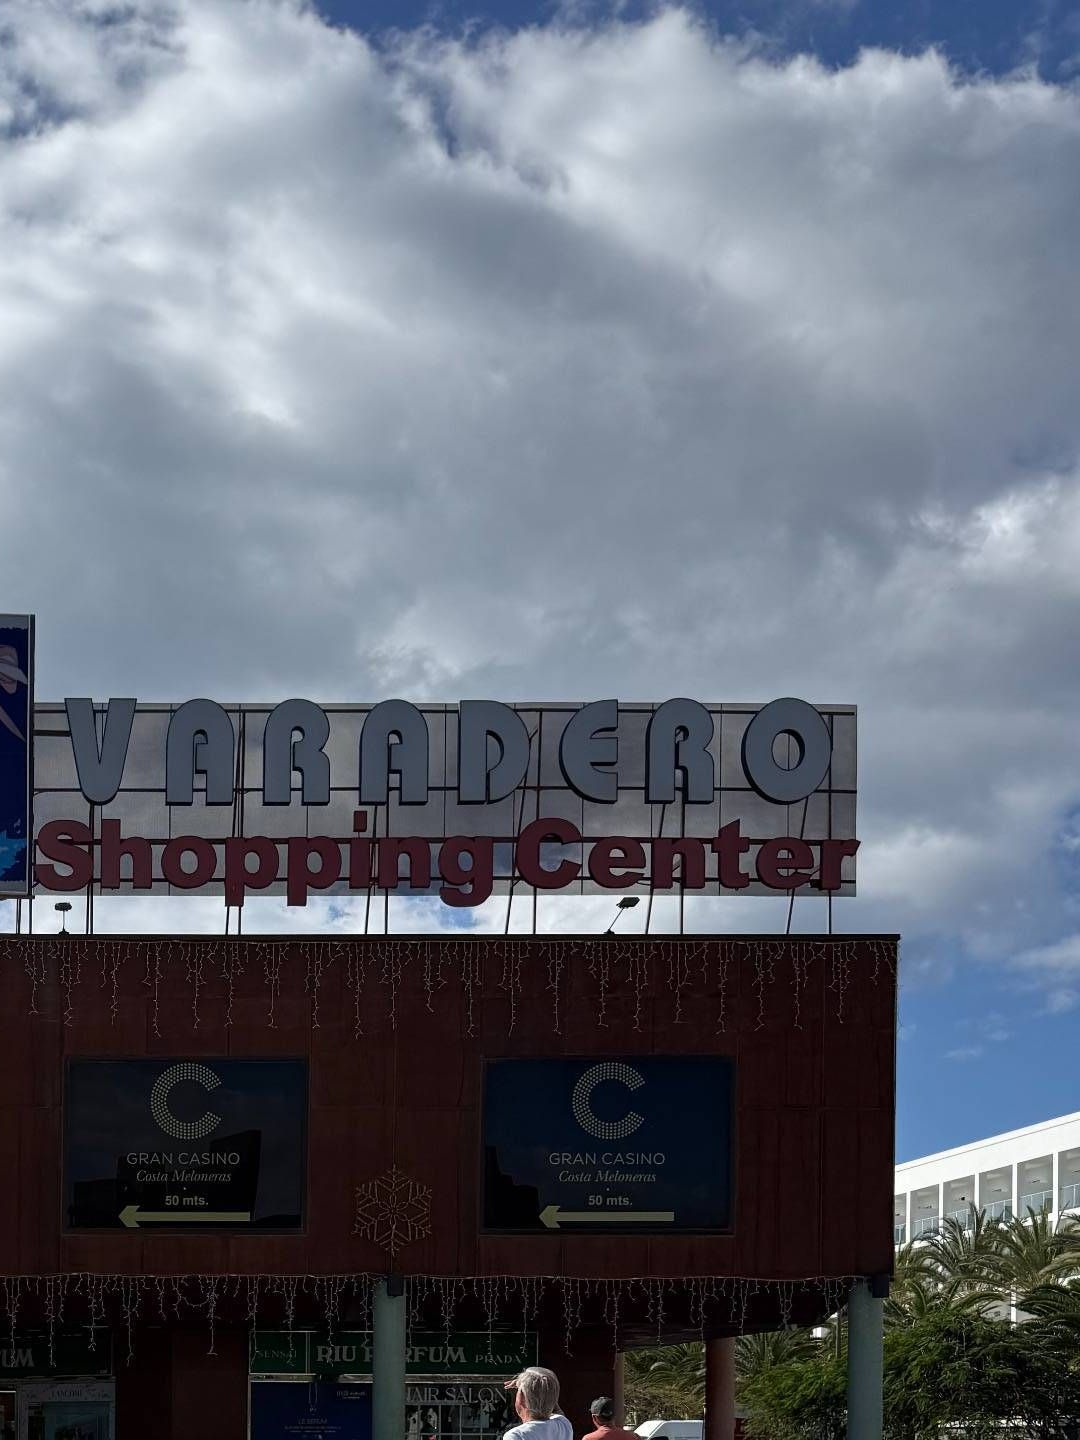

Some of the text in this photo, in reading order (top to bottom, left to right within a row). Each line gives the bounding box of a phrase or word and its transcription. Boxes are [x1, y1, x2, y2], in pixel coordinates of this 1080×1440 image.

[64, 697, 833, 805] VARADERO
[33, 811, 861, 907] Shopping Center
[126, 1152, 240, 1165] GRAN CASINO
[548, 1152, 666, 1165] GRAN CASINO
[137, 1169, 232, 1182] Costa Meloneras
[559, 1170, 657, 1183] Costa Meloneras
[164, 1195, 209, 1206] 50 mts.
[588, 1195, 632, 1206] 50 mts.
[316, 1345, 357, 1362] RIU
[475, 1353, 522, 1364] PRADA
